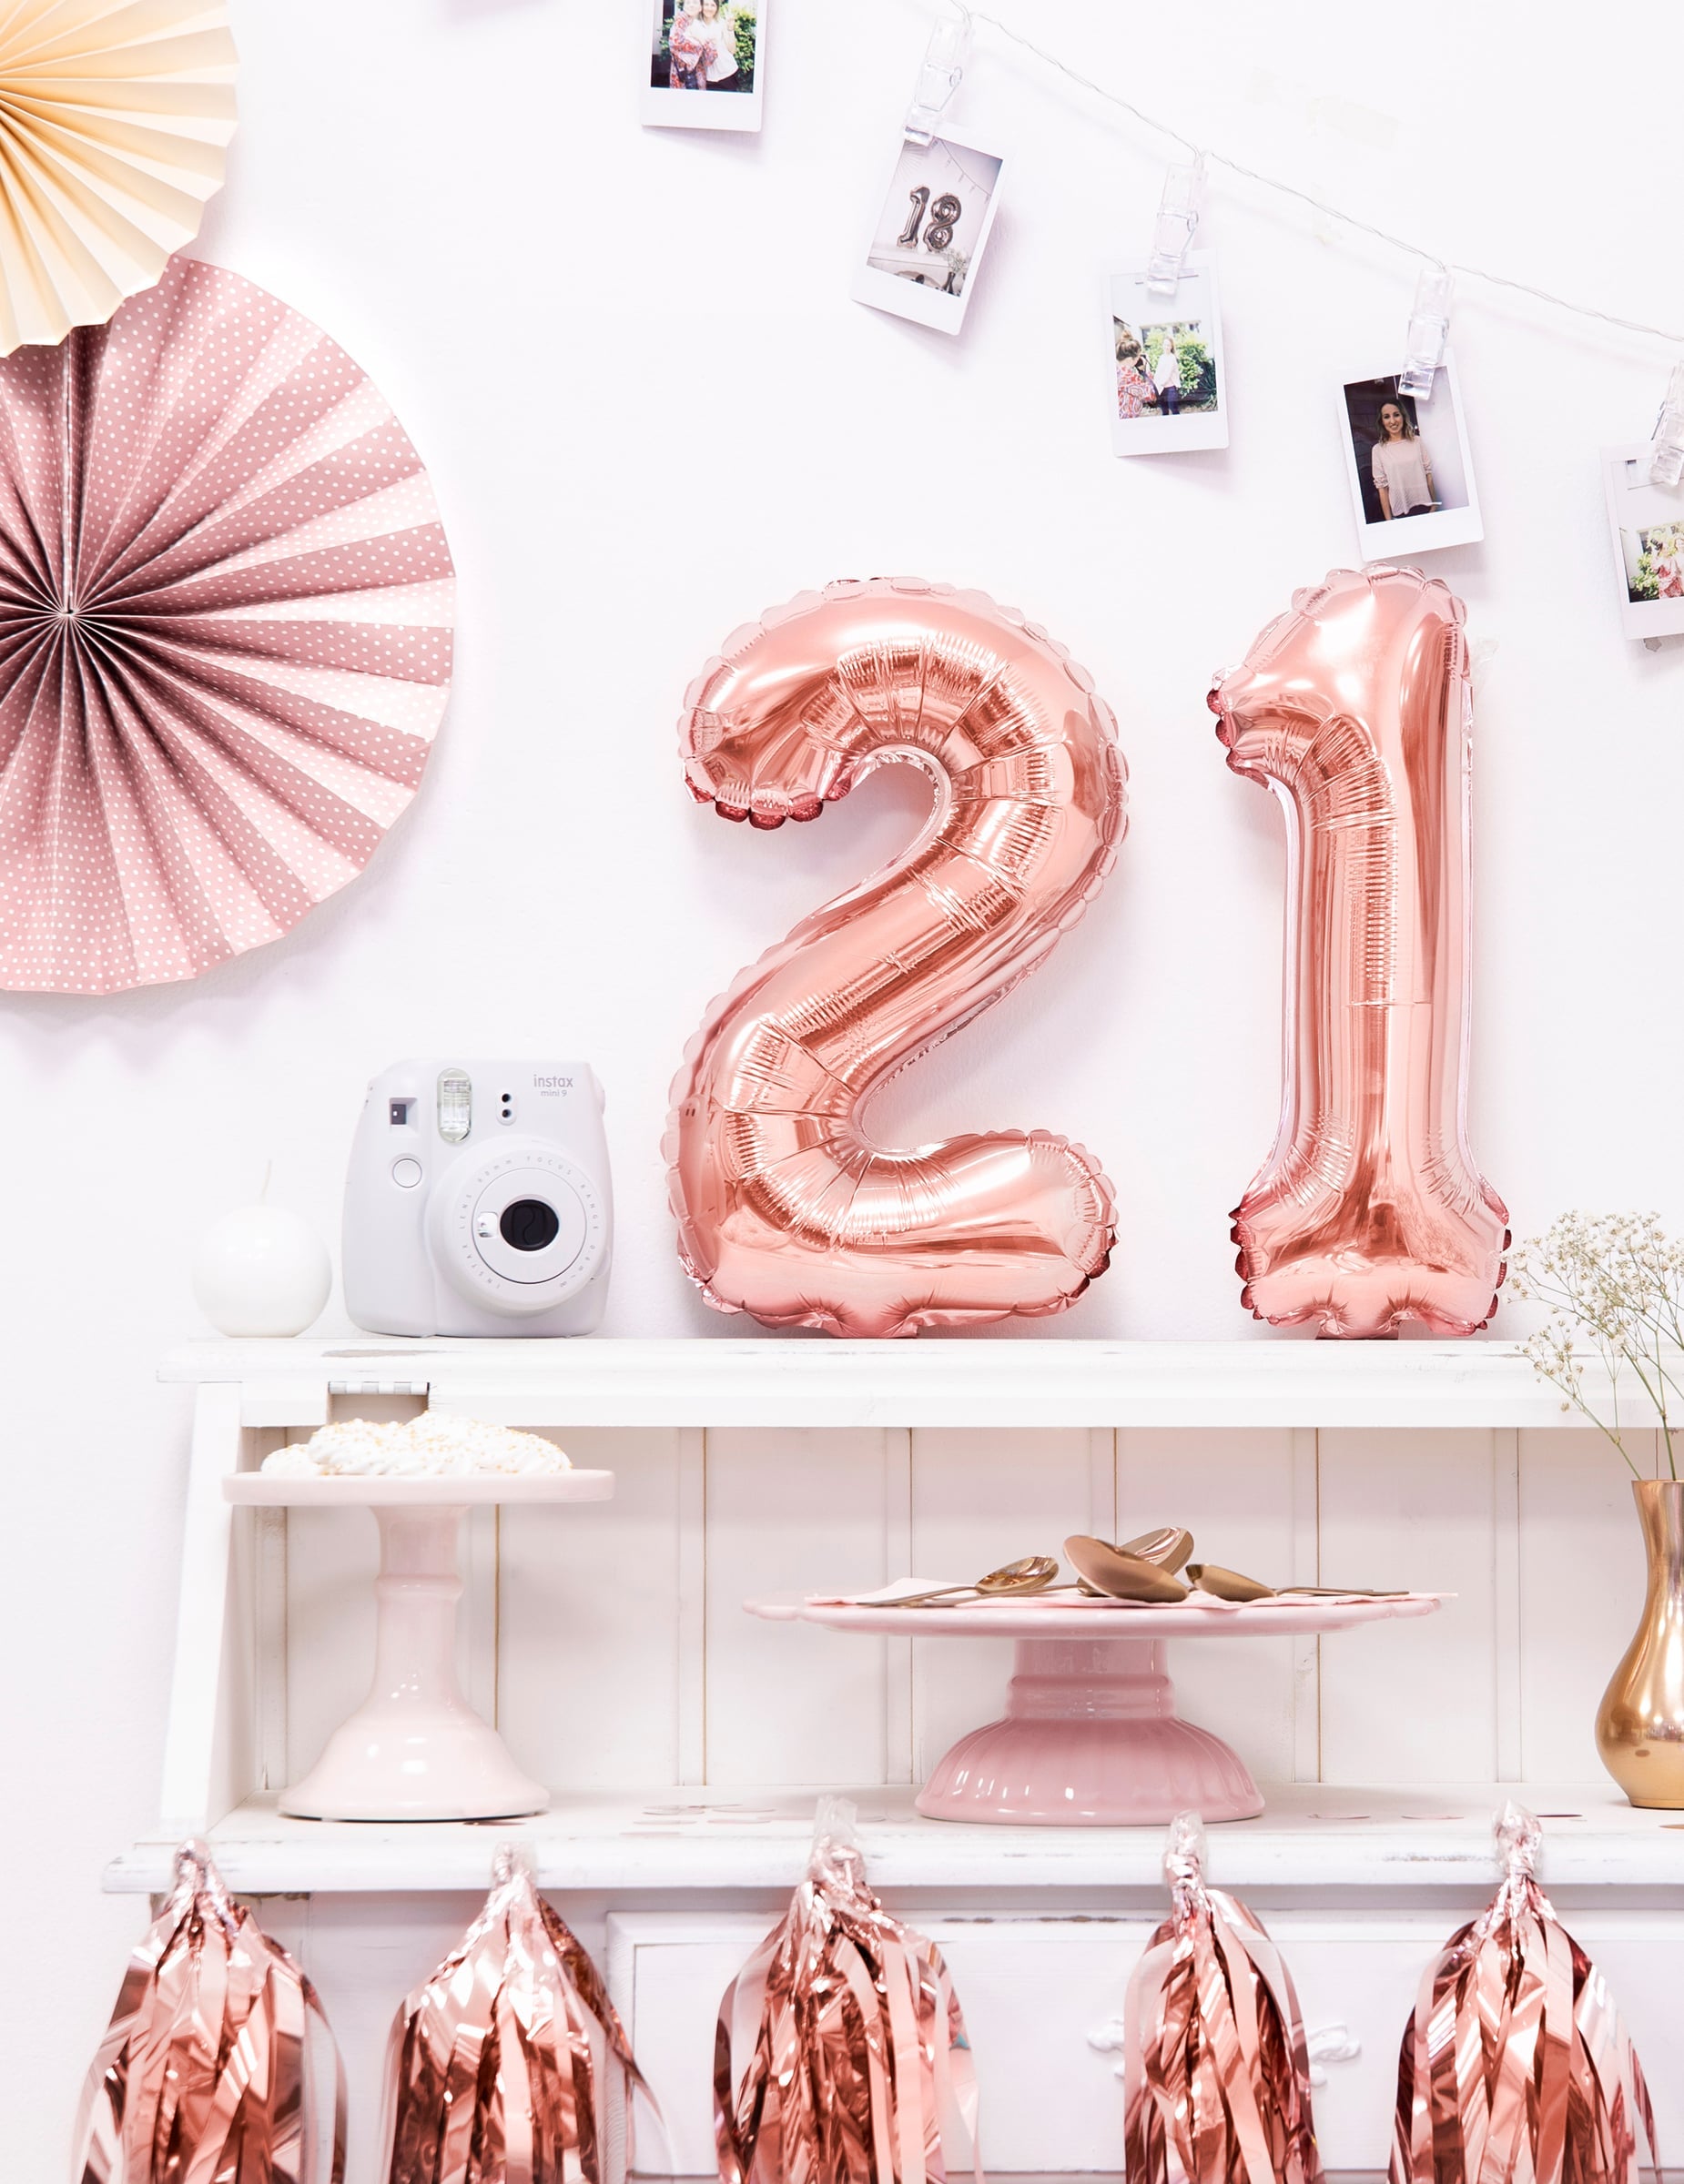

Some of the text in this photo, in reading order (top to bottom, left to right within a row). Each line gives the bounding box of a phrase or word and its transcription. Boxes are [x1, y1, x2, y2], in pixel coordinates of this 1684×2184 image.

[898, 185, 962, 252] 18
[533, 1074, 573, 1087] instax
[561, 1089, 568, 1097] 9
